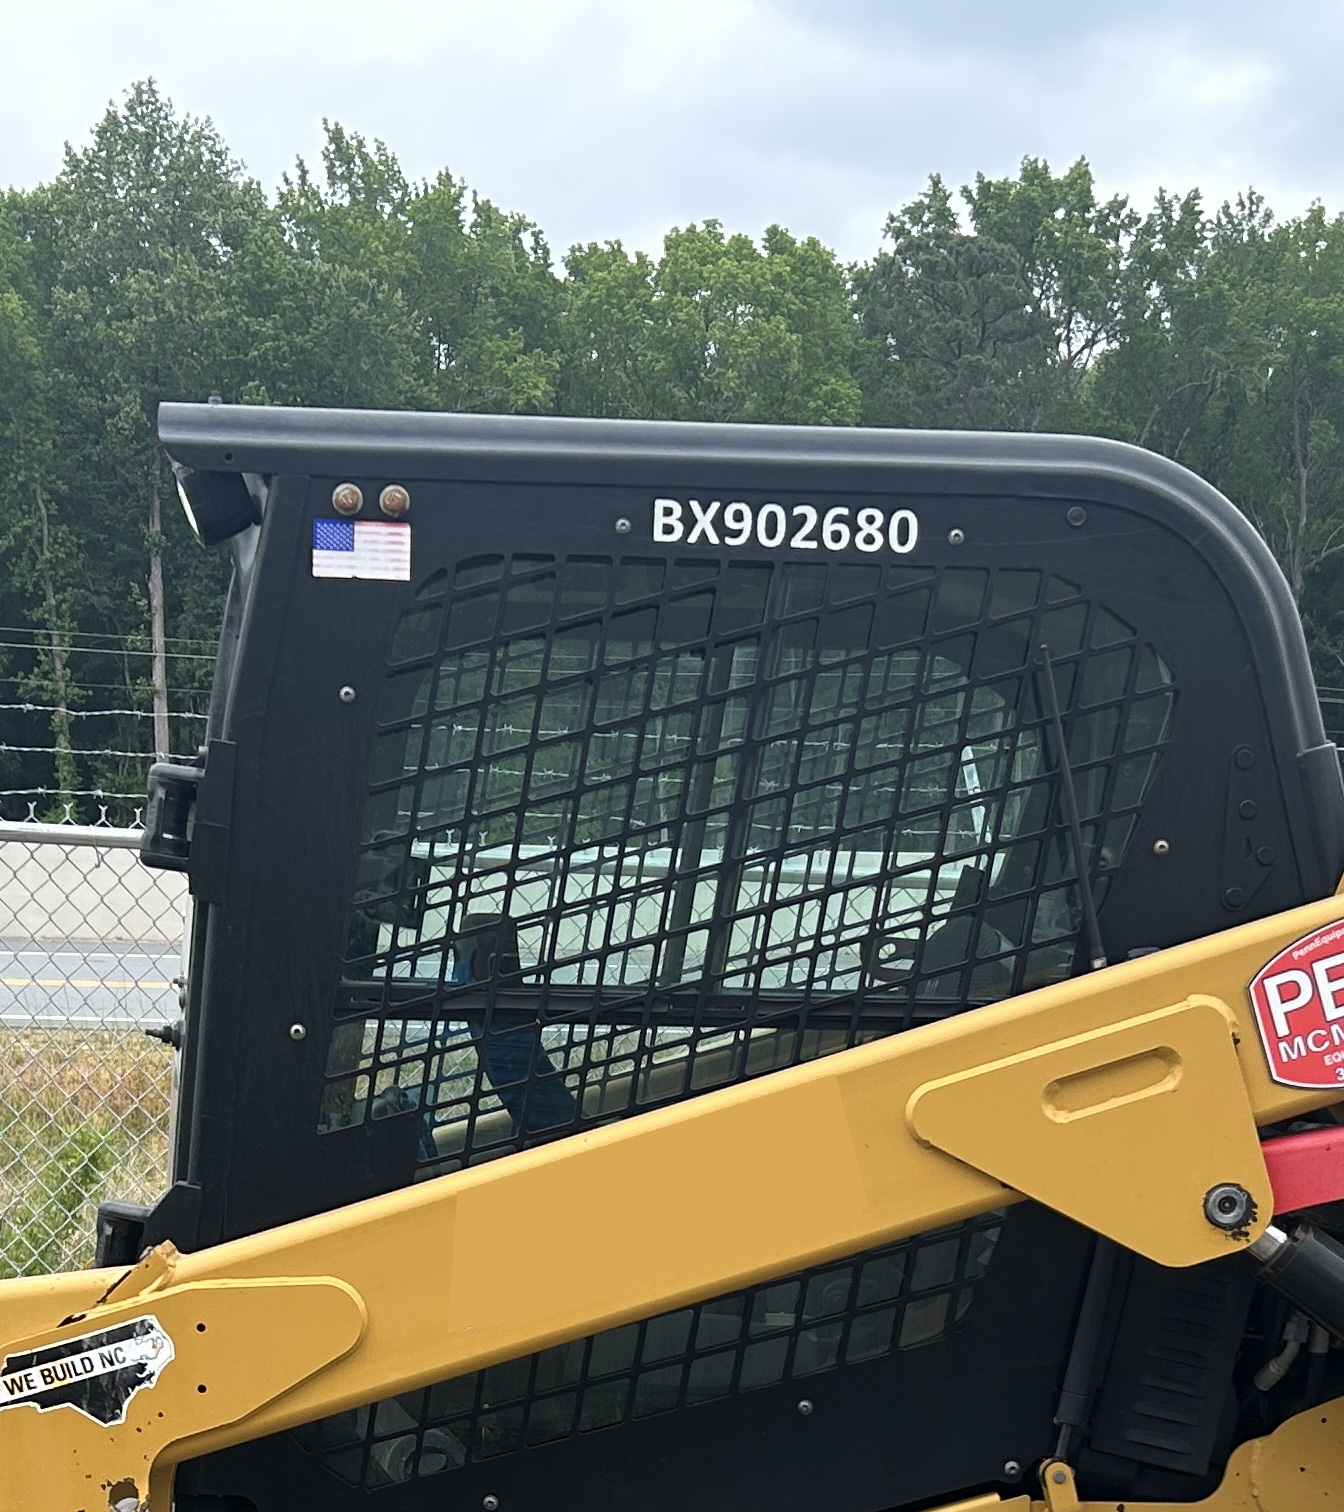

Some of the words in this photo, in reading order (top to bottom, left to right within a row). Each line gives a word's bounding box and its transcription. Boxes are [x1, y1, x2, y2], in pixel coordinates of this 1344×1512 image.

[653, 498, 918, 553] BX902680
[3, 1373, 37, 1396] WE
[40, 1356, 94, 1386] BUILD
[98, 1347, 126, 1369] NC
